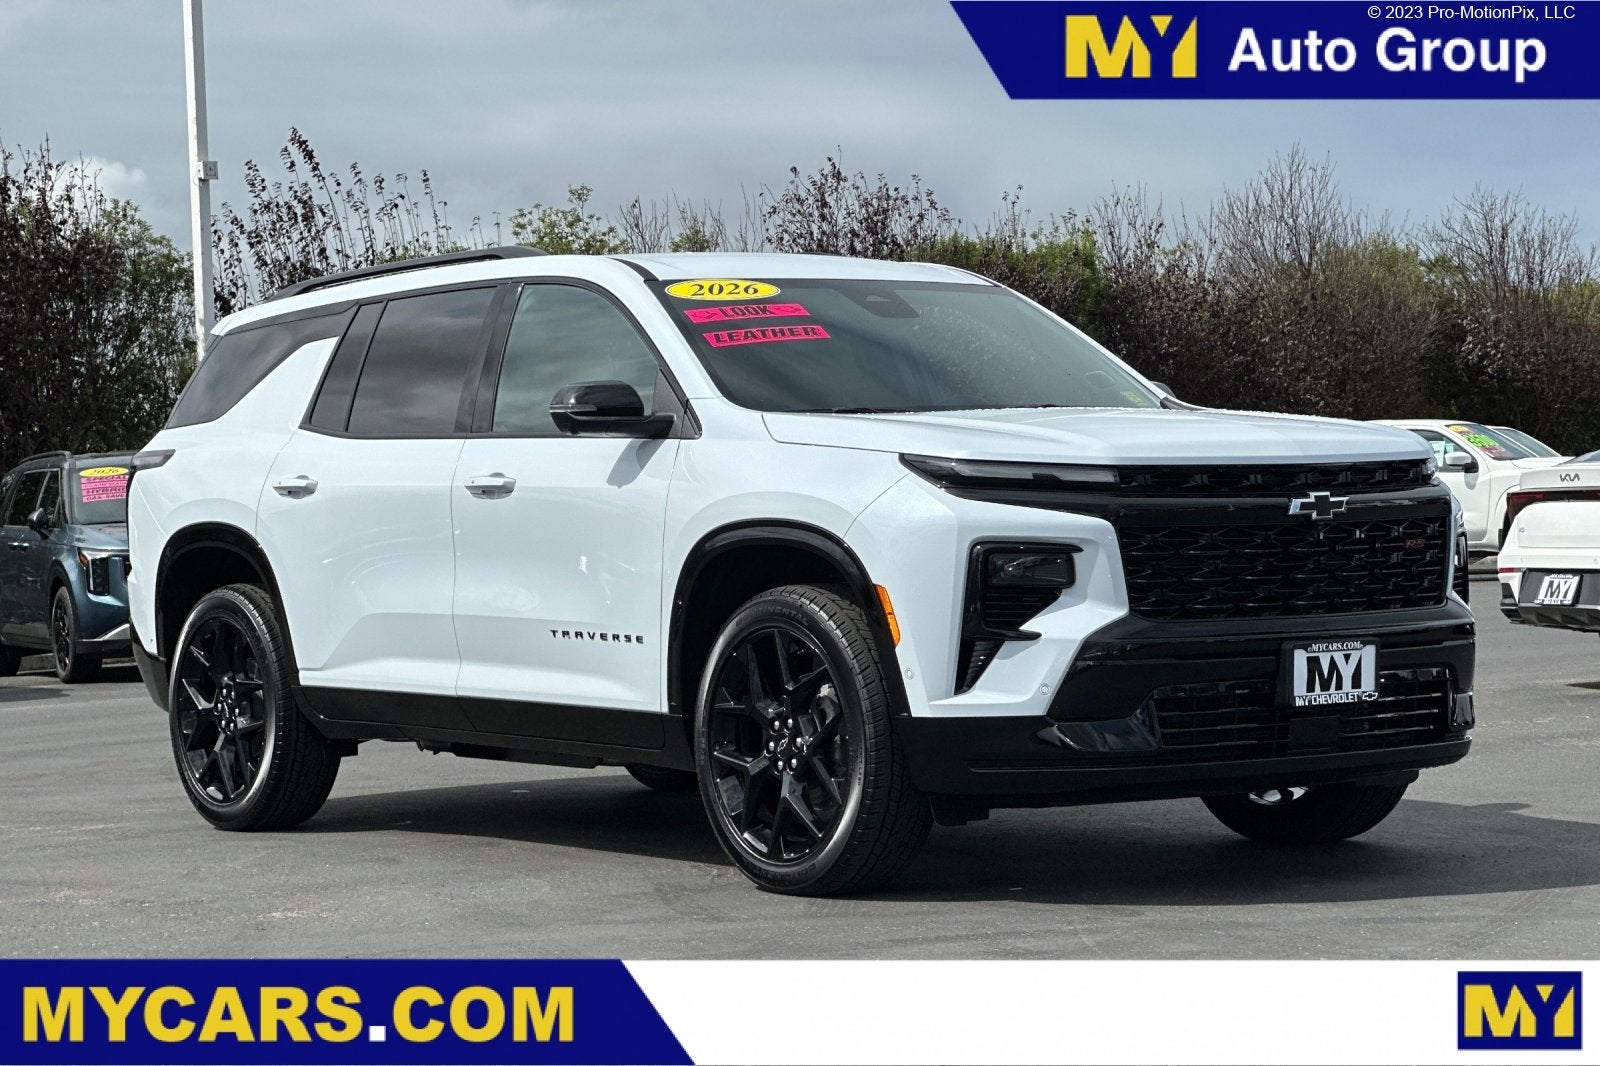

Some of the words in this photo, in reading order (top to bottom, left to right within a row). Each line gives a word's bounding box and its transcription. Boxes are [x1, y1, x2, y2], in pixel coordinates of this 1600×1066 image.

[690, 282, 759, 297] 2026
[718, 304, 776, 318] LOOK
[713, 326, 818, 344] LEATHER
[1544, 580, 1572, 598] MY
[550, 629, 644, 644] TRAVERSE
[1311, 641, 1361, 652] MYCARS.COM
[1306, 652, 1362, 693] MY
[1311, 692, 1359, 706] CHEVROLET
